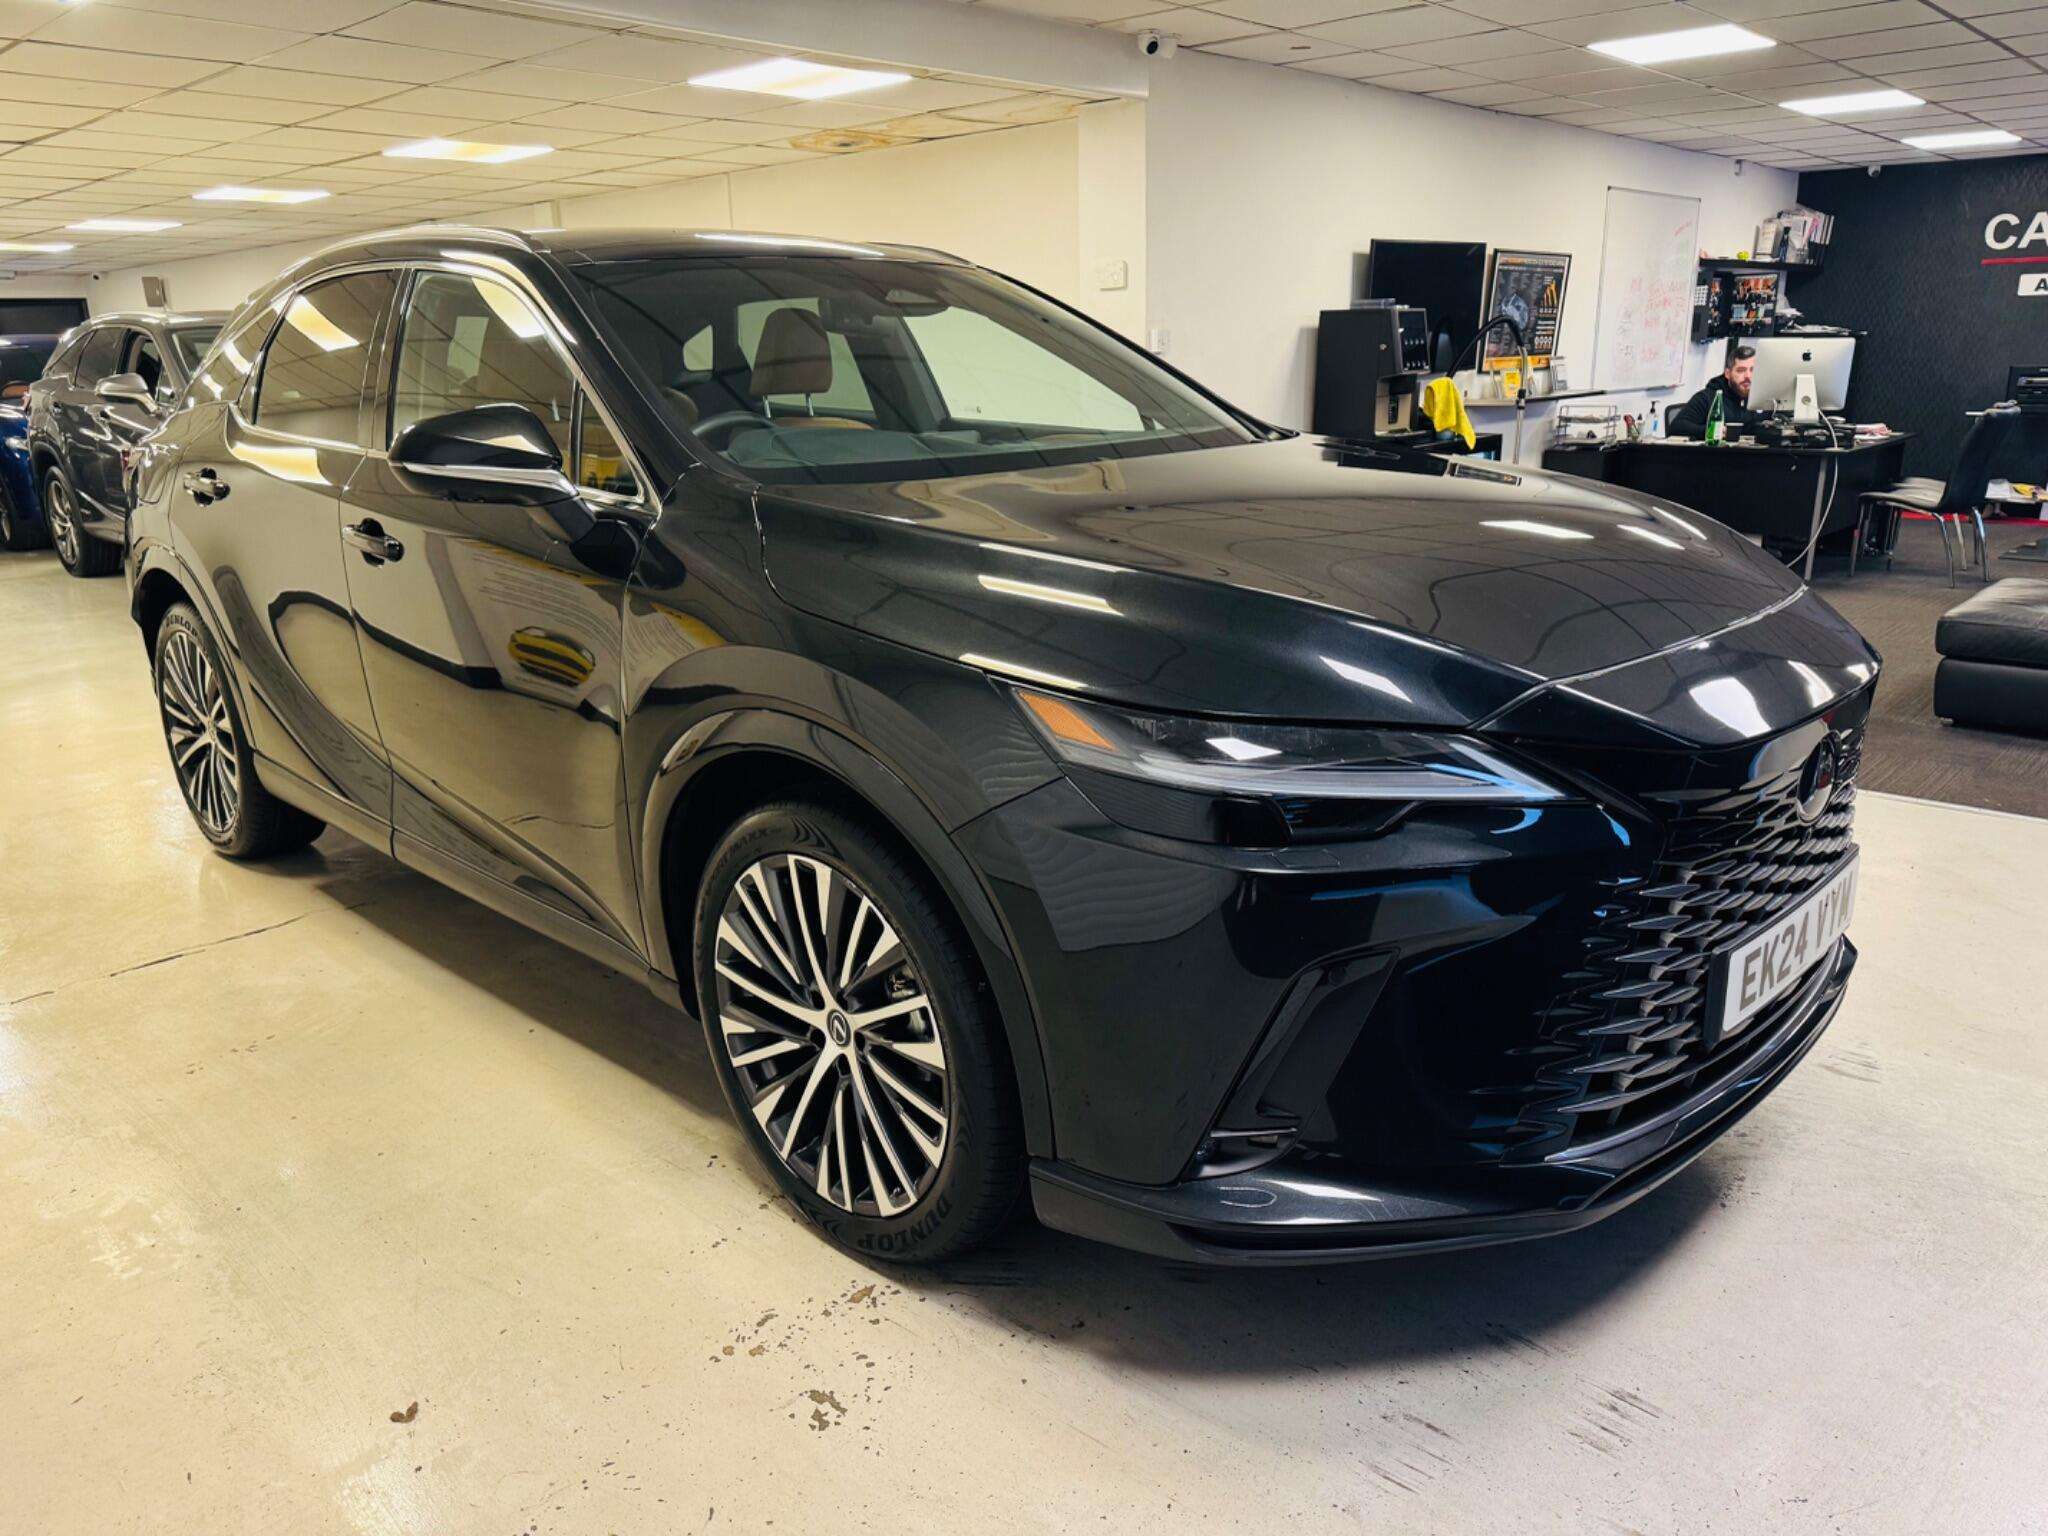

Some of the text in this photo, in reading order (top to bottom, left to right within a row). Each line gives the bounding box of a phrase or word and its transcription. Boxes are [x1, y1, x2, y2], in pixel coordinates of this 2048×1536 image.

[1984, 210, 2048, 251] CA
[1740, 911, 1810, 1011] EK24
[857, 1195, 953, 1253] DUNLOP
